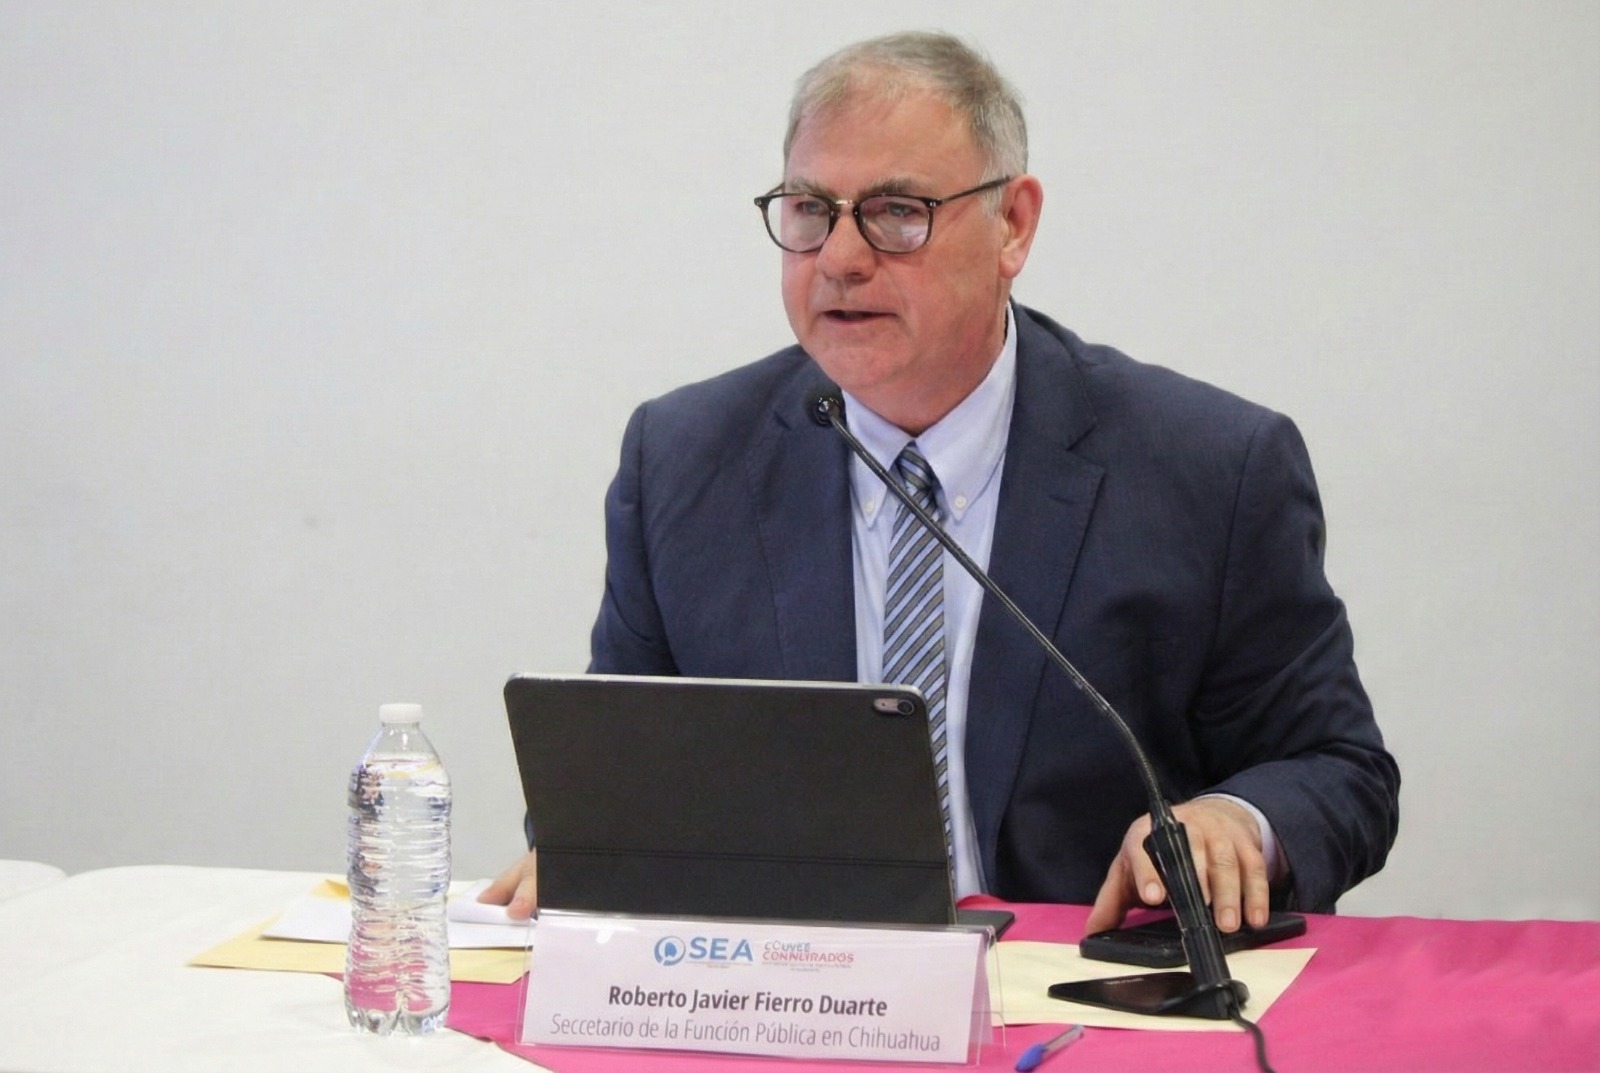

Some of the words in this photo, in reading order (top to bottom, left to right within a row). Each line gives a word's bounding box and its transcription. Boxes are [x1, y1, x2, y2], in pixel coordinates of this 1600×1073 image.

[688, 936, 754, 962] SEA
[608, 985, 687, 1008] Roberto
[690, 989, 750, 1013] Javier
[754, 992, 814, 1014] Fierro
[819, 995, 888, 1016] Duarte
[550, 1013, 634, 1038] Seccetario
[638, 1017, 659, 1039] de
[664, 1018, 679, 1040] la
[684, 1019, 750, 1043] Función
[755, 1022, 816, 1046] Pública
[821, 1029, 843, 1047] en
[848, 1026, 941, 1052] Chihuahua
